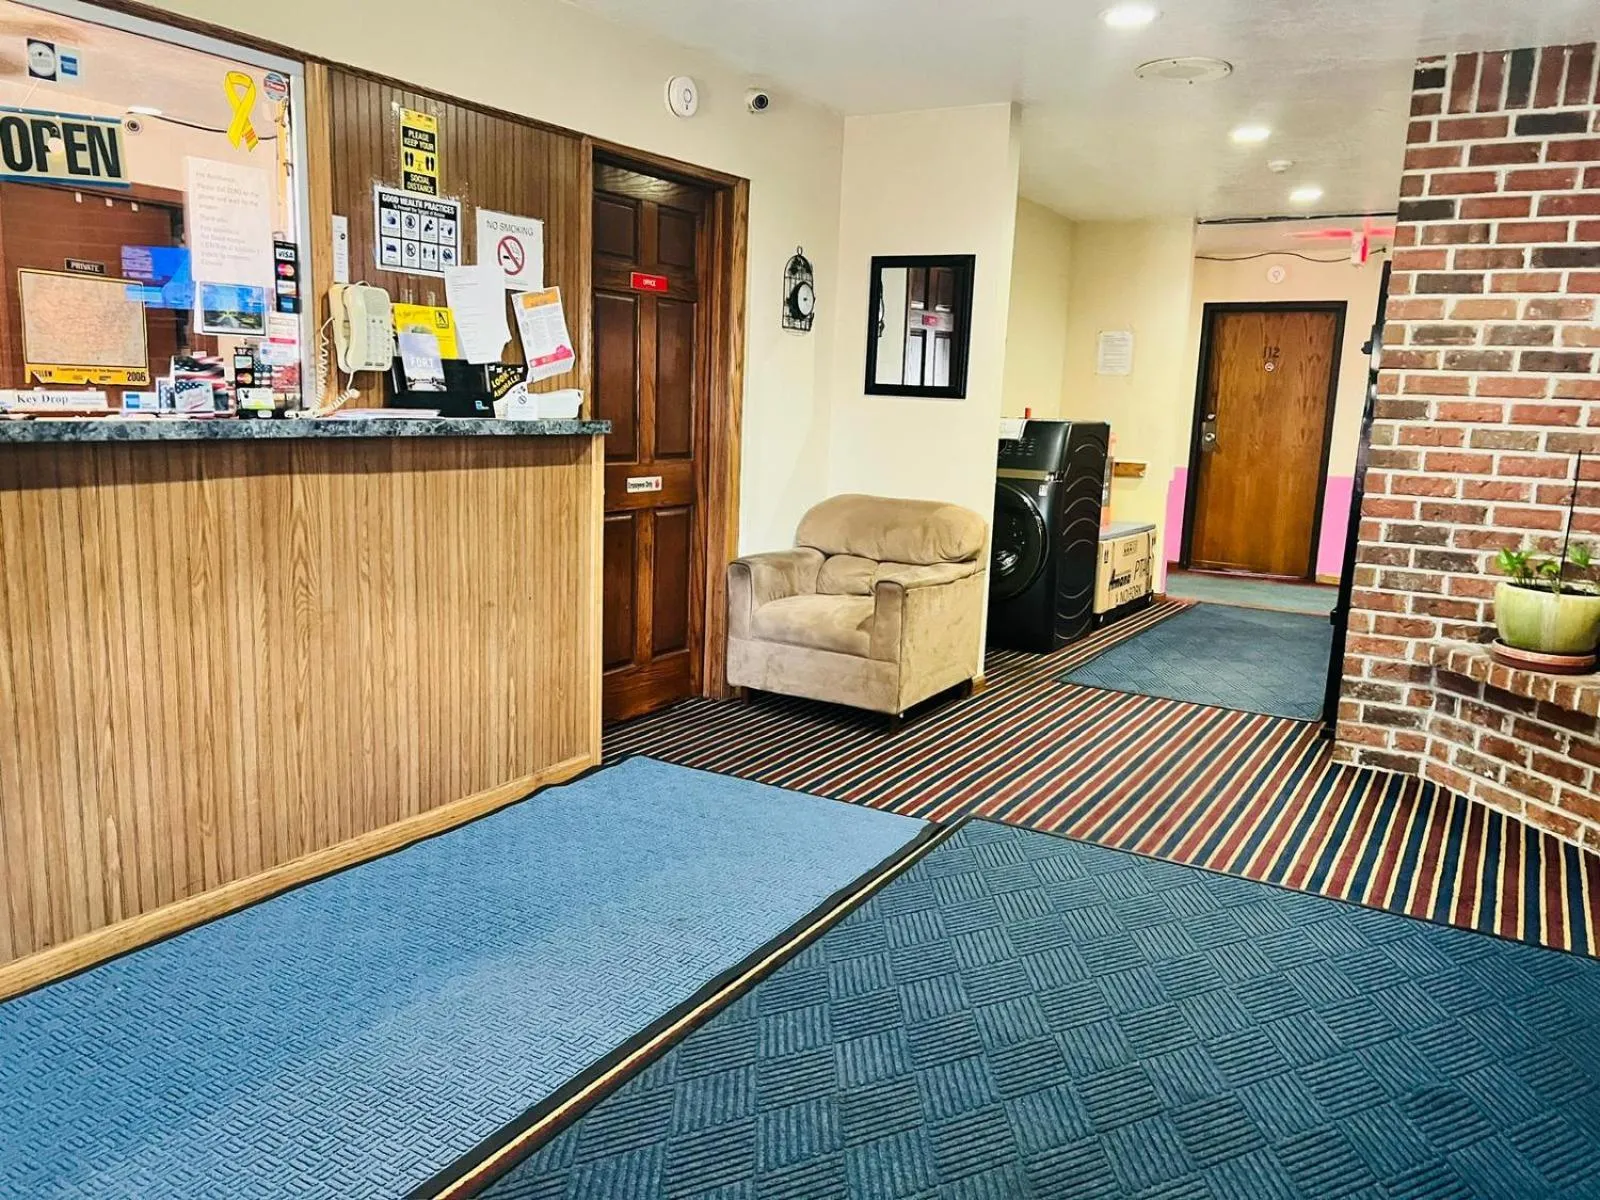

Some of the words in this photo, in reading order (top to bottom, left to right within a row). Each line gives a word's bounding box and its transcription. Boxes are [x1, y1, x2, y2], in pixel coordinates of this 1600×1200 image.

[407, 130, 430, 142] PLEASE
[0, 115, 122, 178] OPEN
[403, 138, 419, 148] KEEP
[420, 141, 435, 151] YOUR
[410, 173, 430, 185] SOCIAL
[406, 182, 435, 194] DISTANCE
[423, 201, 455, 214] PRACTICES
[486, 220, 498, 230] NO
[500, 222, 534, 236] SMOKING
[278, 249, 294, 259] VISA
[70, 261, 101, 273] PRIVATE
[1263, 345, 1281, 359] 112
[126, 371, 147, 382] 2006
[16, 393, 36, 406] Key
[42, 394, 69, 406] Drop
